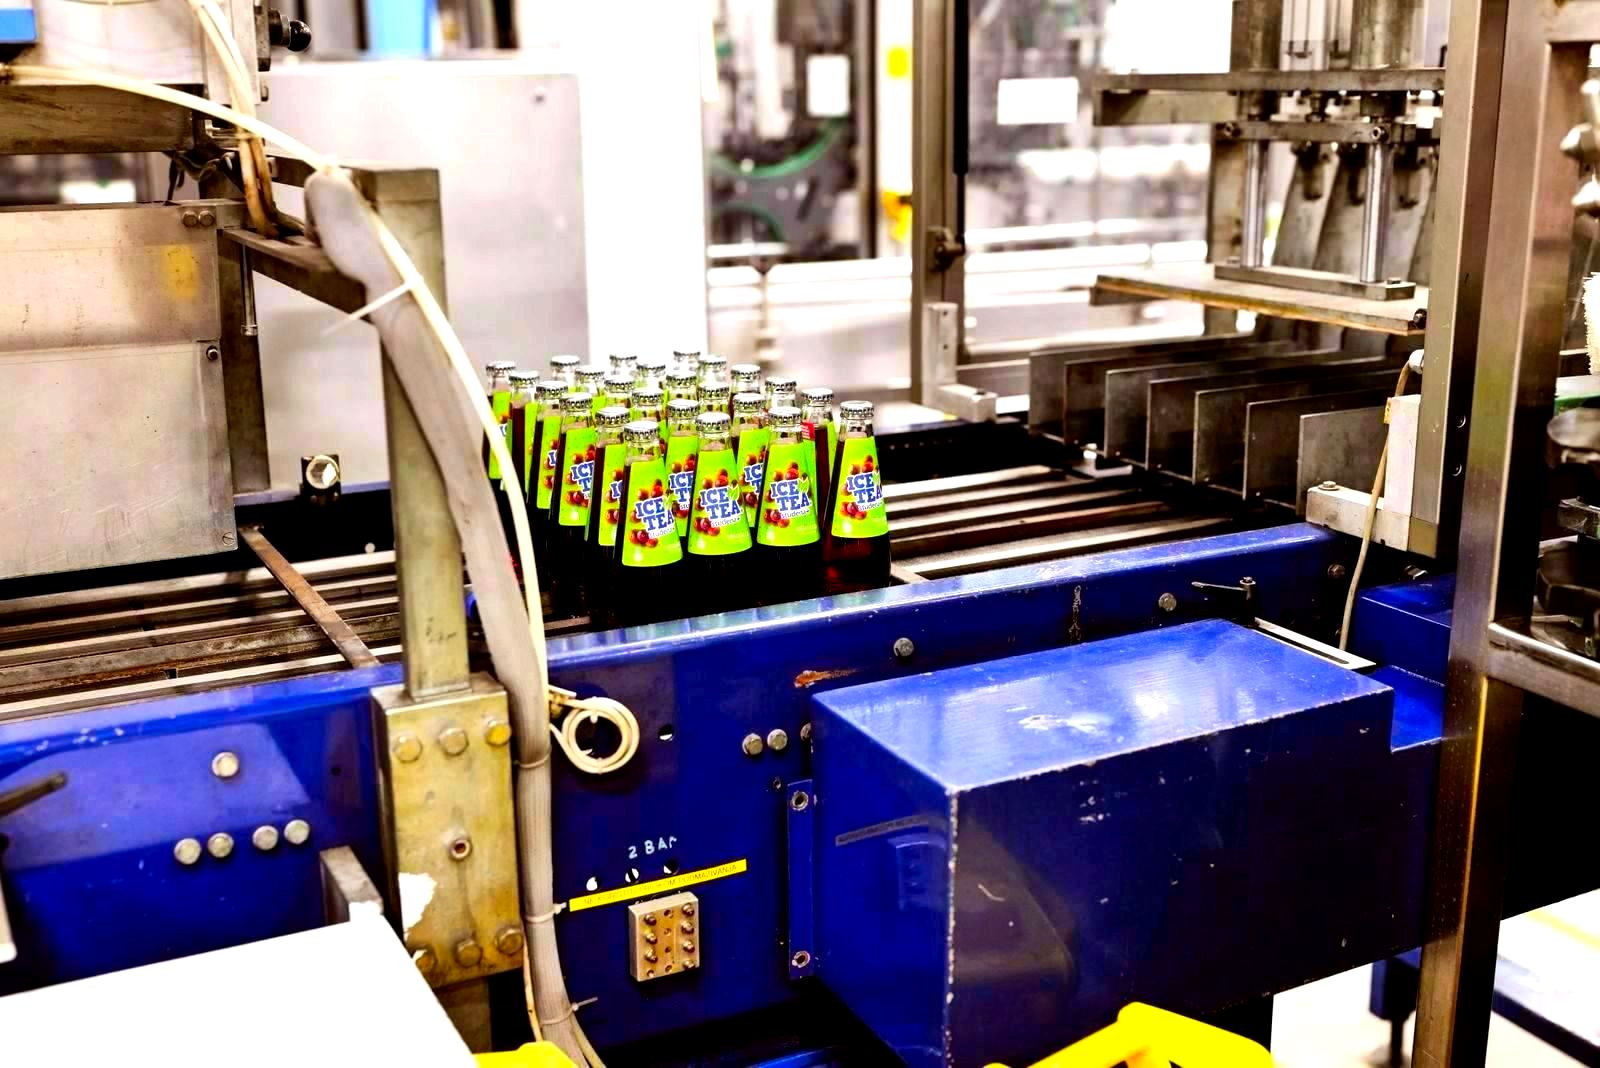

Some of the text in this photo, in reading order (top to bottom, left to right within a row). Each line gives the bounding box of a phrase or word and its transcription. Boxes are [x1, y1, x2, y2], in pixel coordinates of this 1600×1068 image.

[771, 480, 800, 498] ICE
[847, 473, 875, 491] ICE
[700, 489, 729, 506] ICE
[777, 493, 810, 512] TEA
[854, 486, 882, 504] TEA
[635, 498, 665, 517] ICE
[706, 500, 740, 519] TEA
[643, 509, 674, 531] TEA
[628, 846, 638, 859] 2
